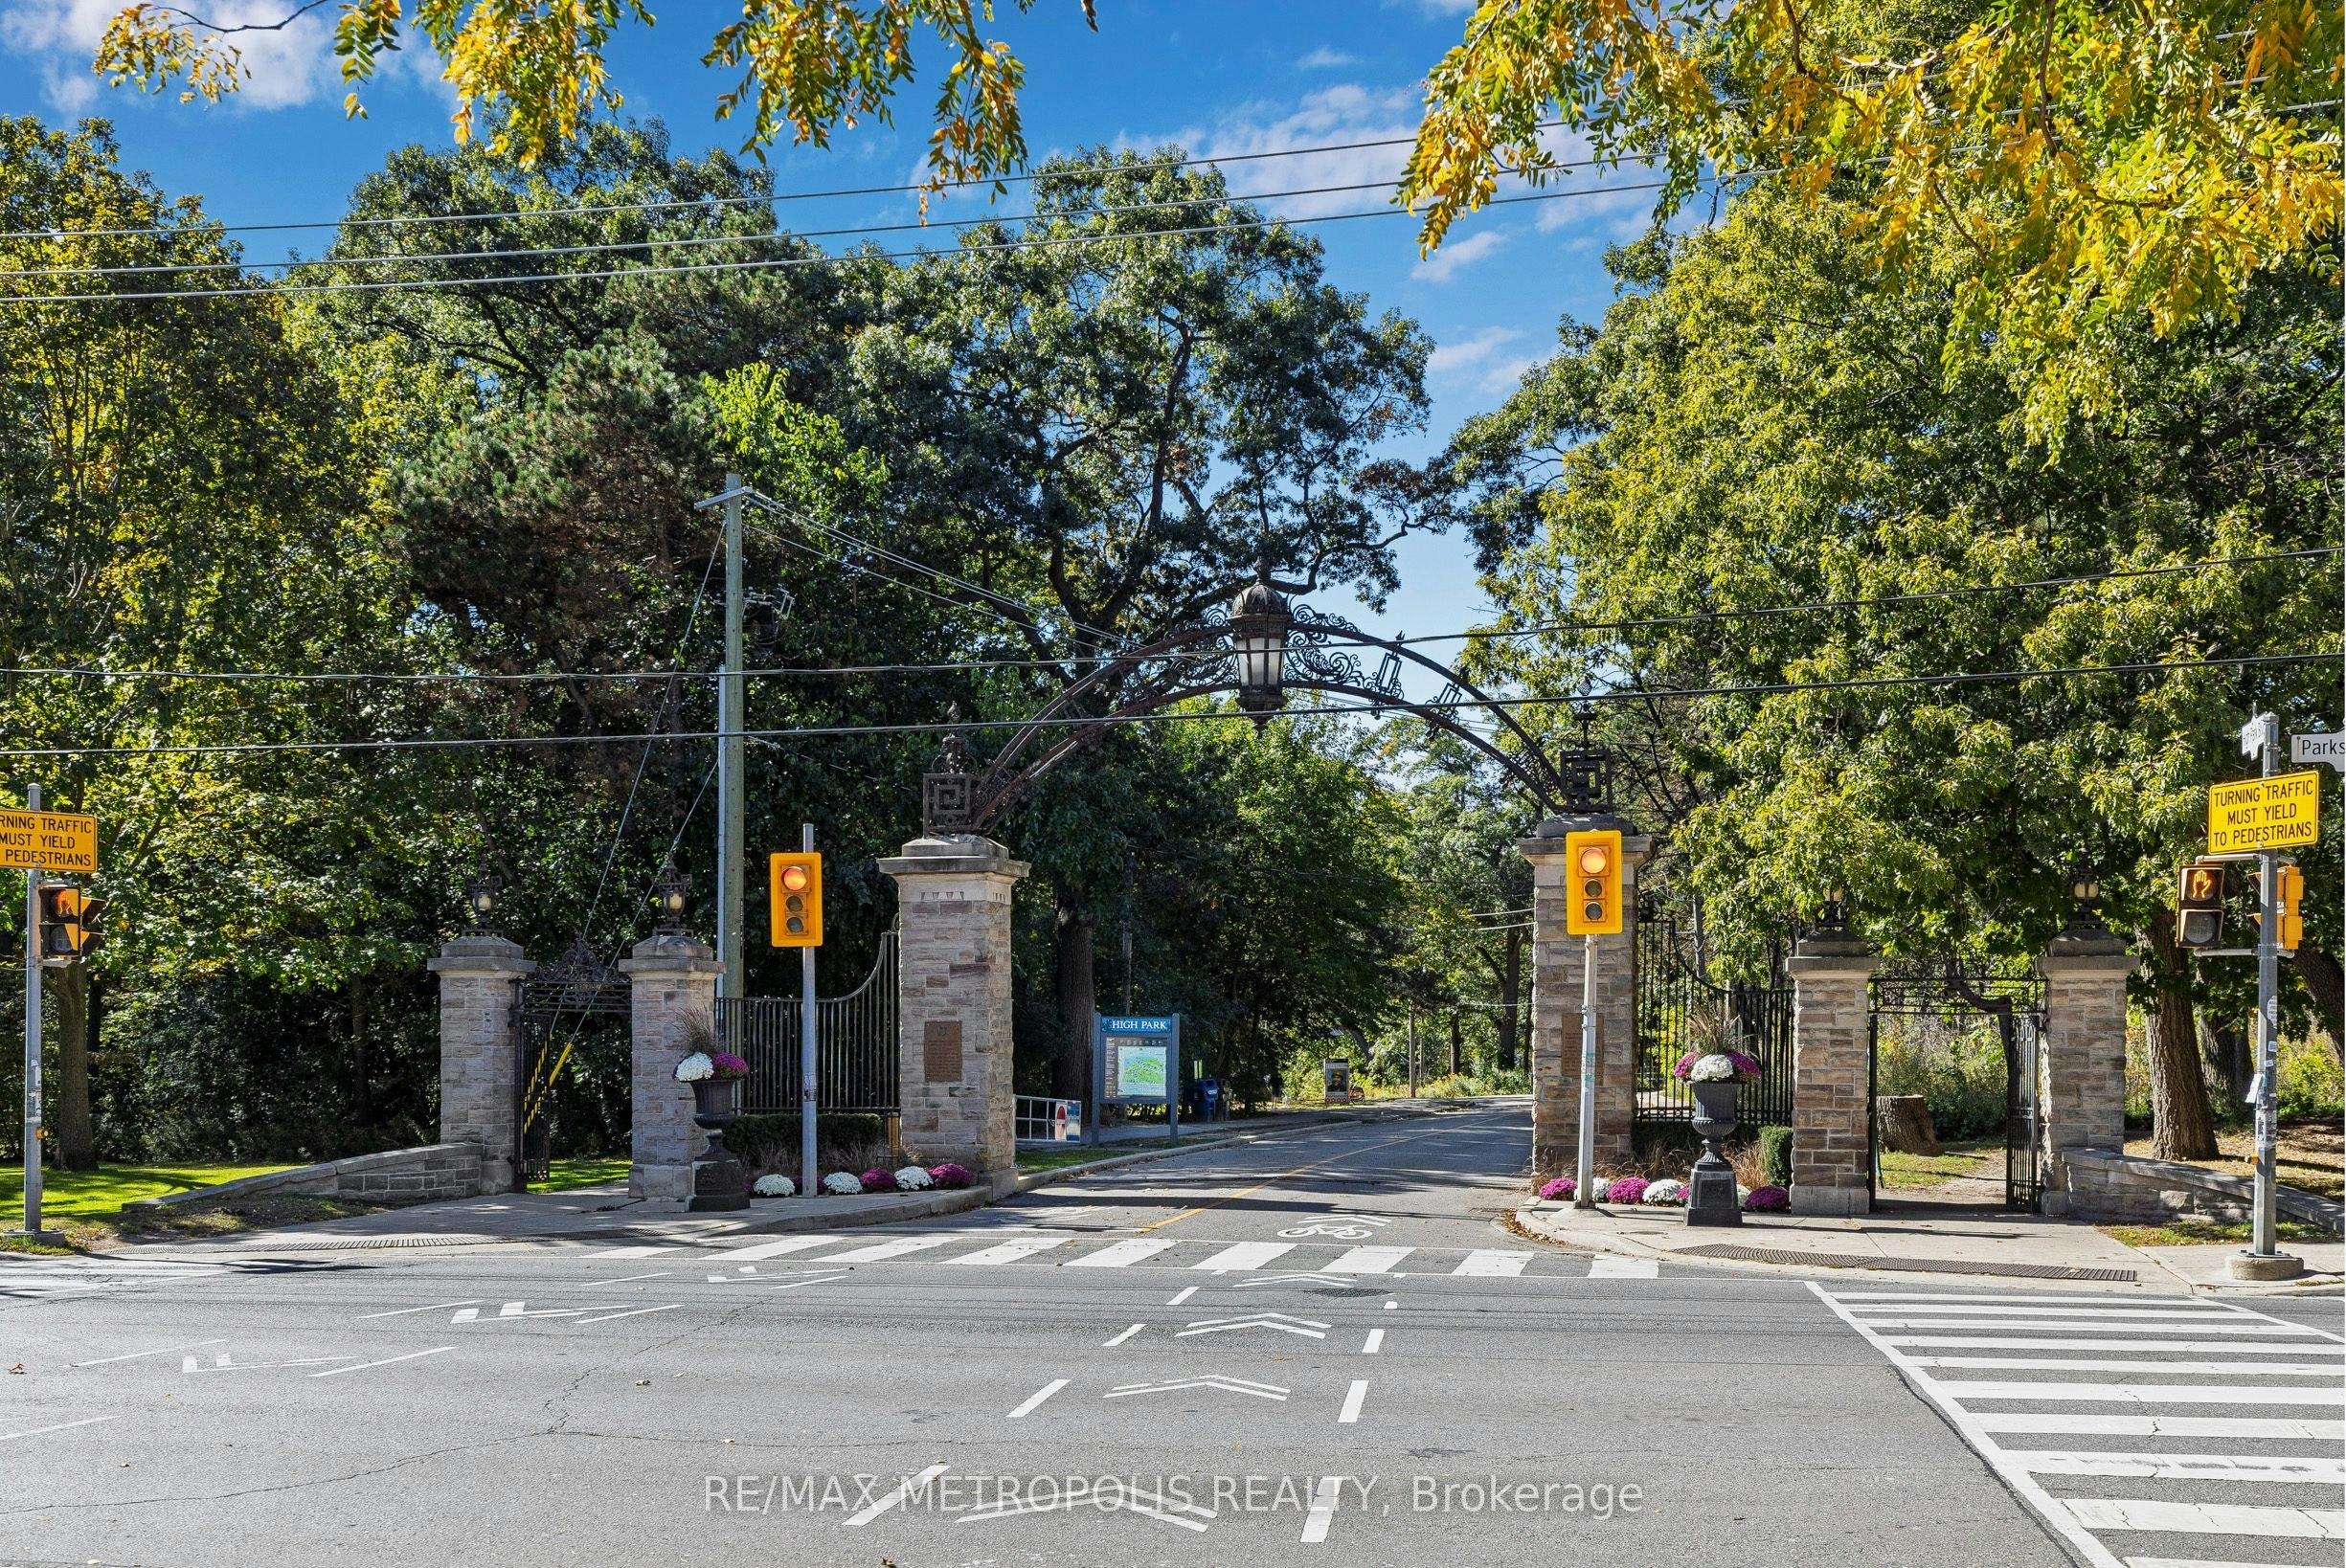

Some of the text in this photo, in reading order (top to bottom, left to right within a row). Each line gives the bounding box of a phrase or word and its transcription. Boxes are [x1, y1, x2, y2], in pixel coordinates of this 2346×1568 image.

[2214, 779, 2313, 807] TURNING TRAFFIC
[2227, 803, 2297, 825] MUST YIELD
[40, 818, 92, 834] TRAFFIC
[2214, 821, 2312, 847] TO PEDESTRIANS
[0, 832, 76, 849] MUST YIELD
[6, 849, 91, 867] PEDESTRIANS
[1112, 1020, 1167, 1029] HIGH PARK
